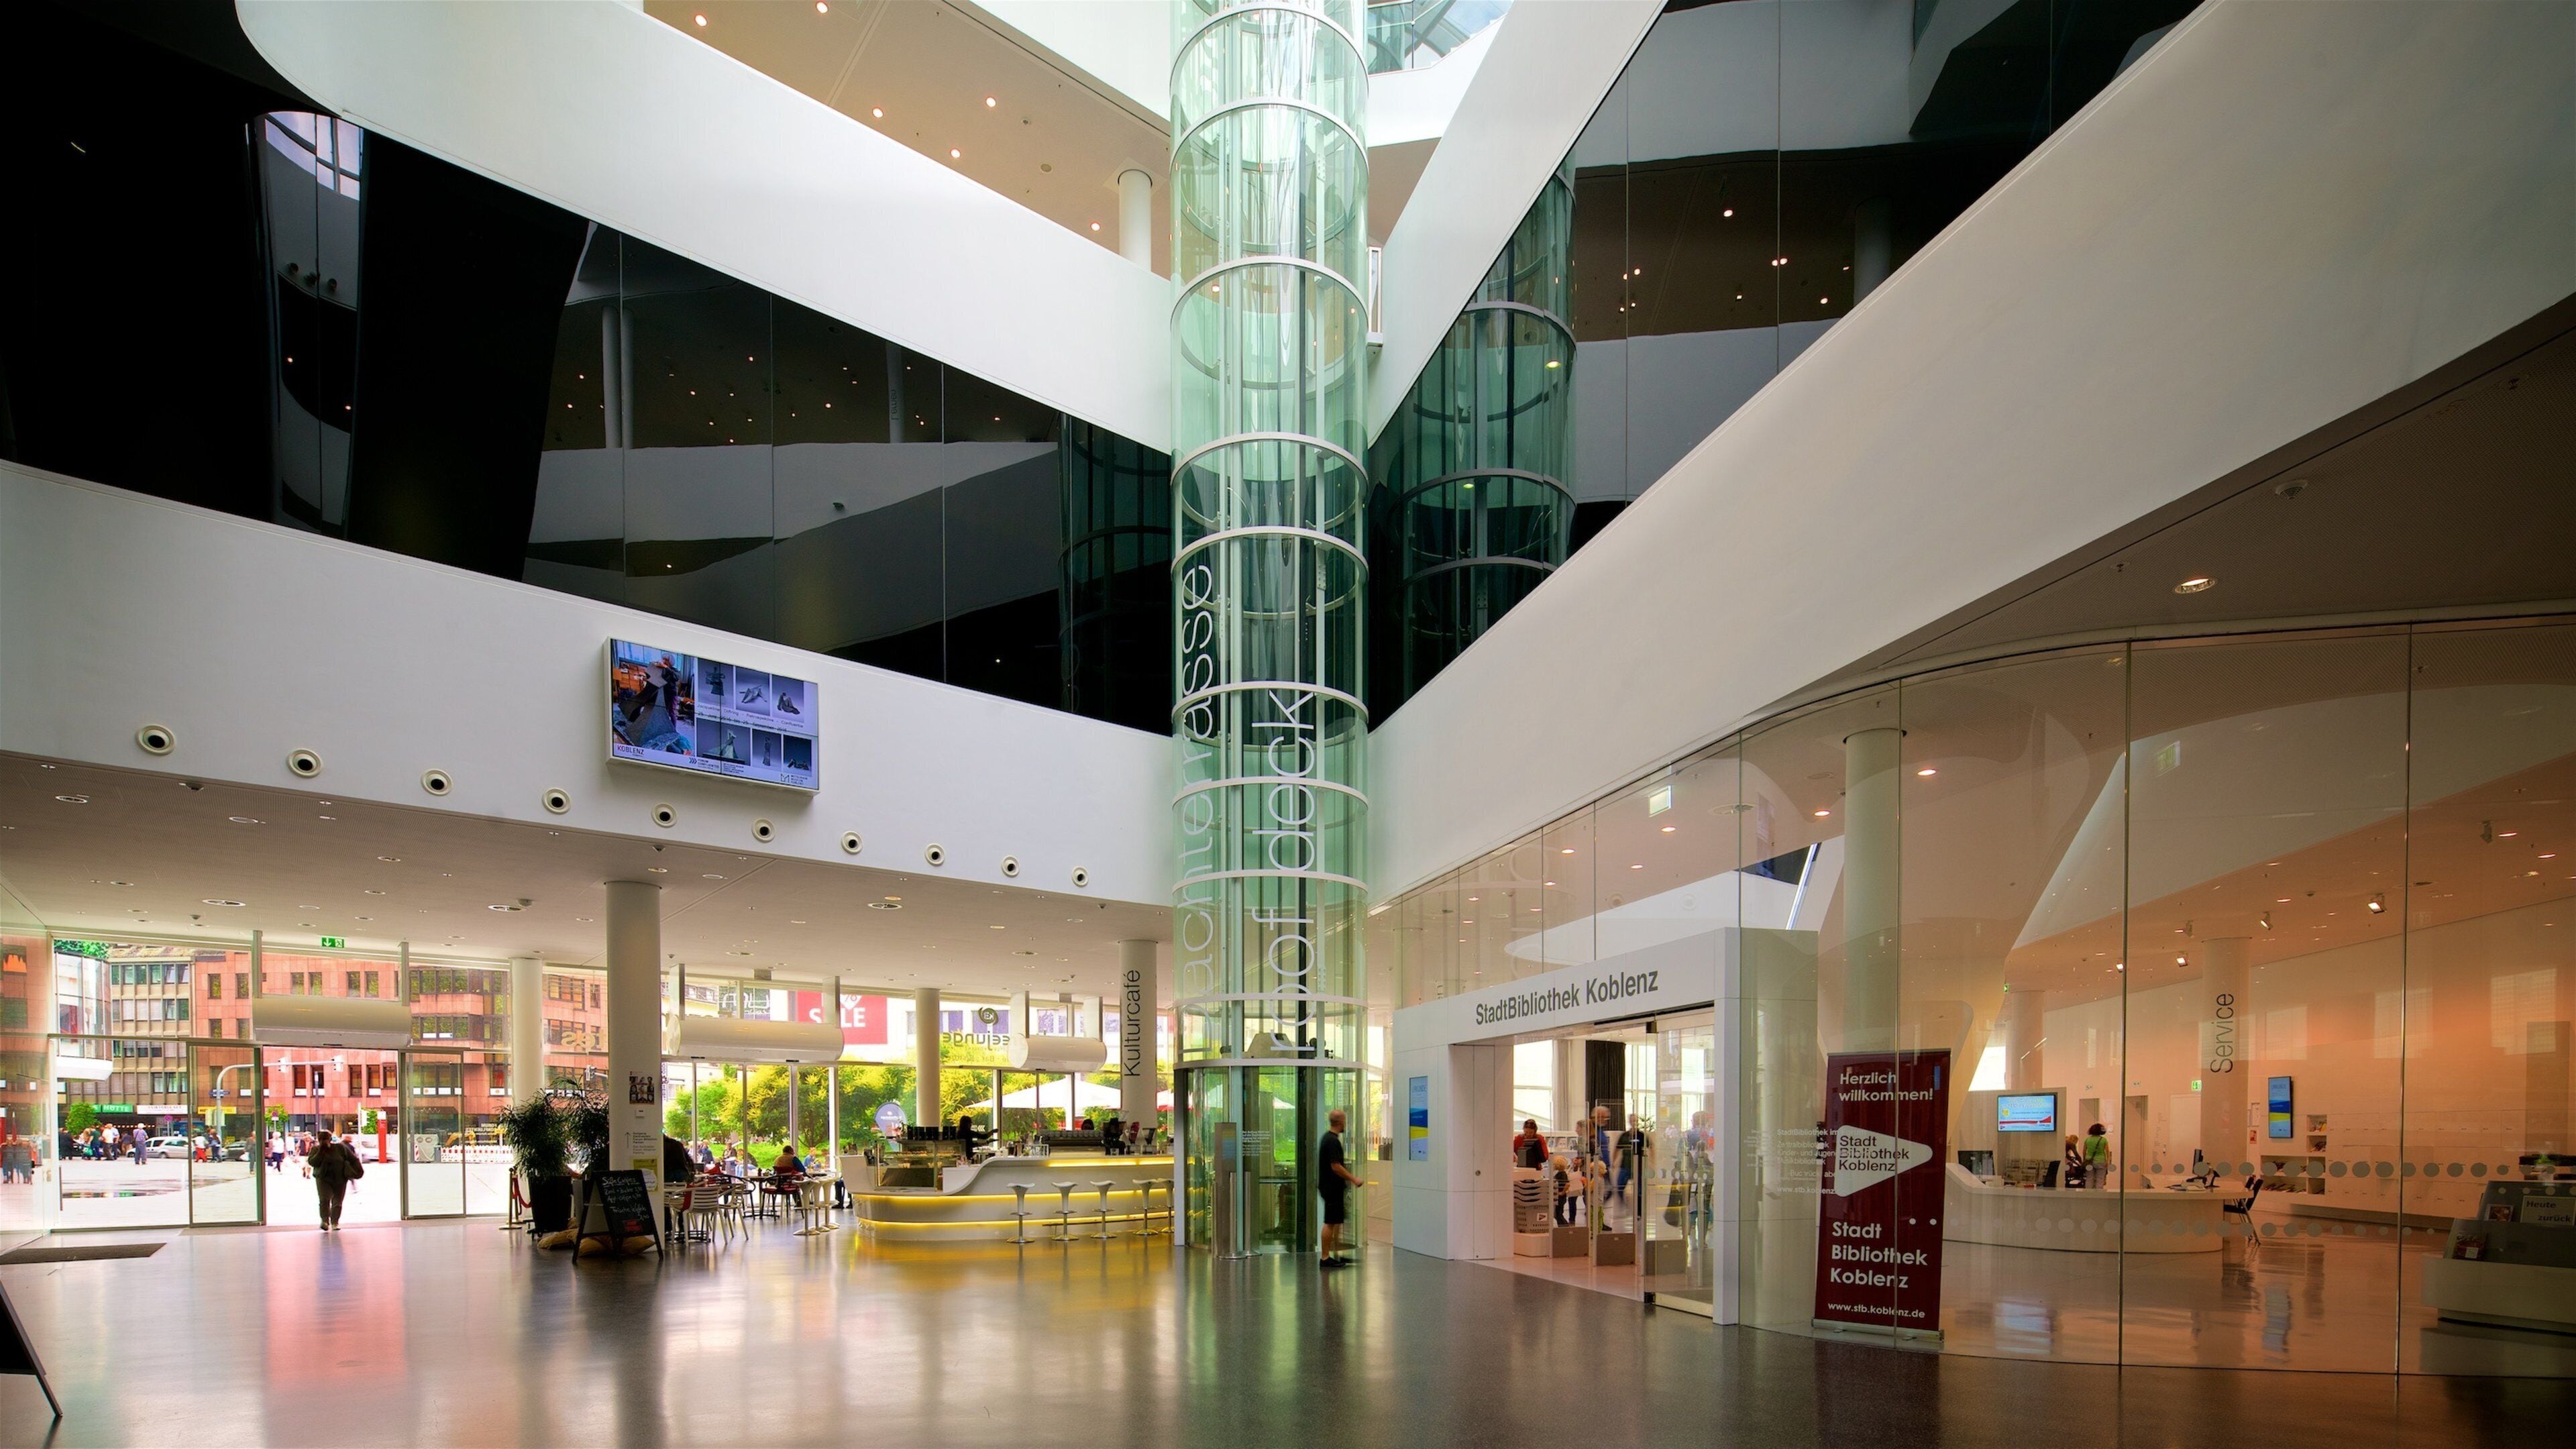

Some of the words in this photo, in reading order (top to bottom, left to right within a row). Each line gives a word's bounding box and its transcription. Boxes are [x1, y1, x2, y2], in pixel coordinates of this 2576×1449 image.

[617, 745, 644, 755] KOBLENZ
[1252, 690, 1316, 871] deck
[1252, 907, 1316, 1051] roof
[1476, 983, 1580, 1025] StadtBibliothek
[1587, 971, 1658, 1005] Koblenz
[809, 1008, 866, 1028] SLE
[1124, 970, 1140, 1077] Kulturcafé
[2210, 994, 2234, 1074] Service
[1840, 1072, 1896, 1085] Herzlich
[1839, 1088, 1933, 1101] willkommen!
[1776, 1128, 1829, 1136] StadtBibliothek
[1839, 1135, 1878, 1148] Stadt
[1839, 1147, 1911, 1160] Bibliothek
[1839, 1159, 1896, 1171] Koblenz
[1832, 1221, 1882, 1239] Stadt
[1831, 1244, 1928, 1266] Bibliothek
[1830, 1267, 1909, 1288] Koblenz
[1828, 1303, 1925, 1318] www.stb.koblenz.de
